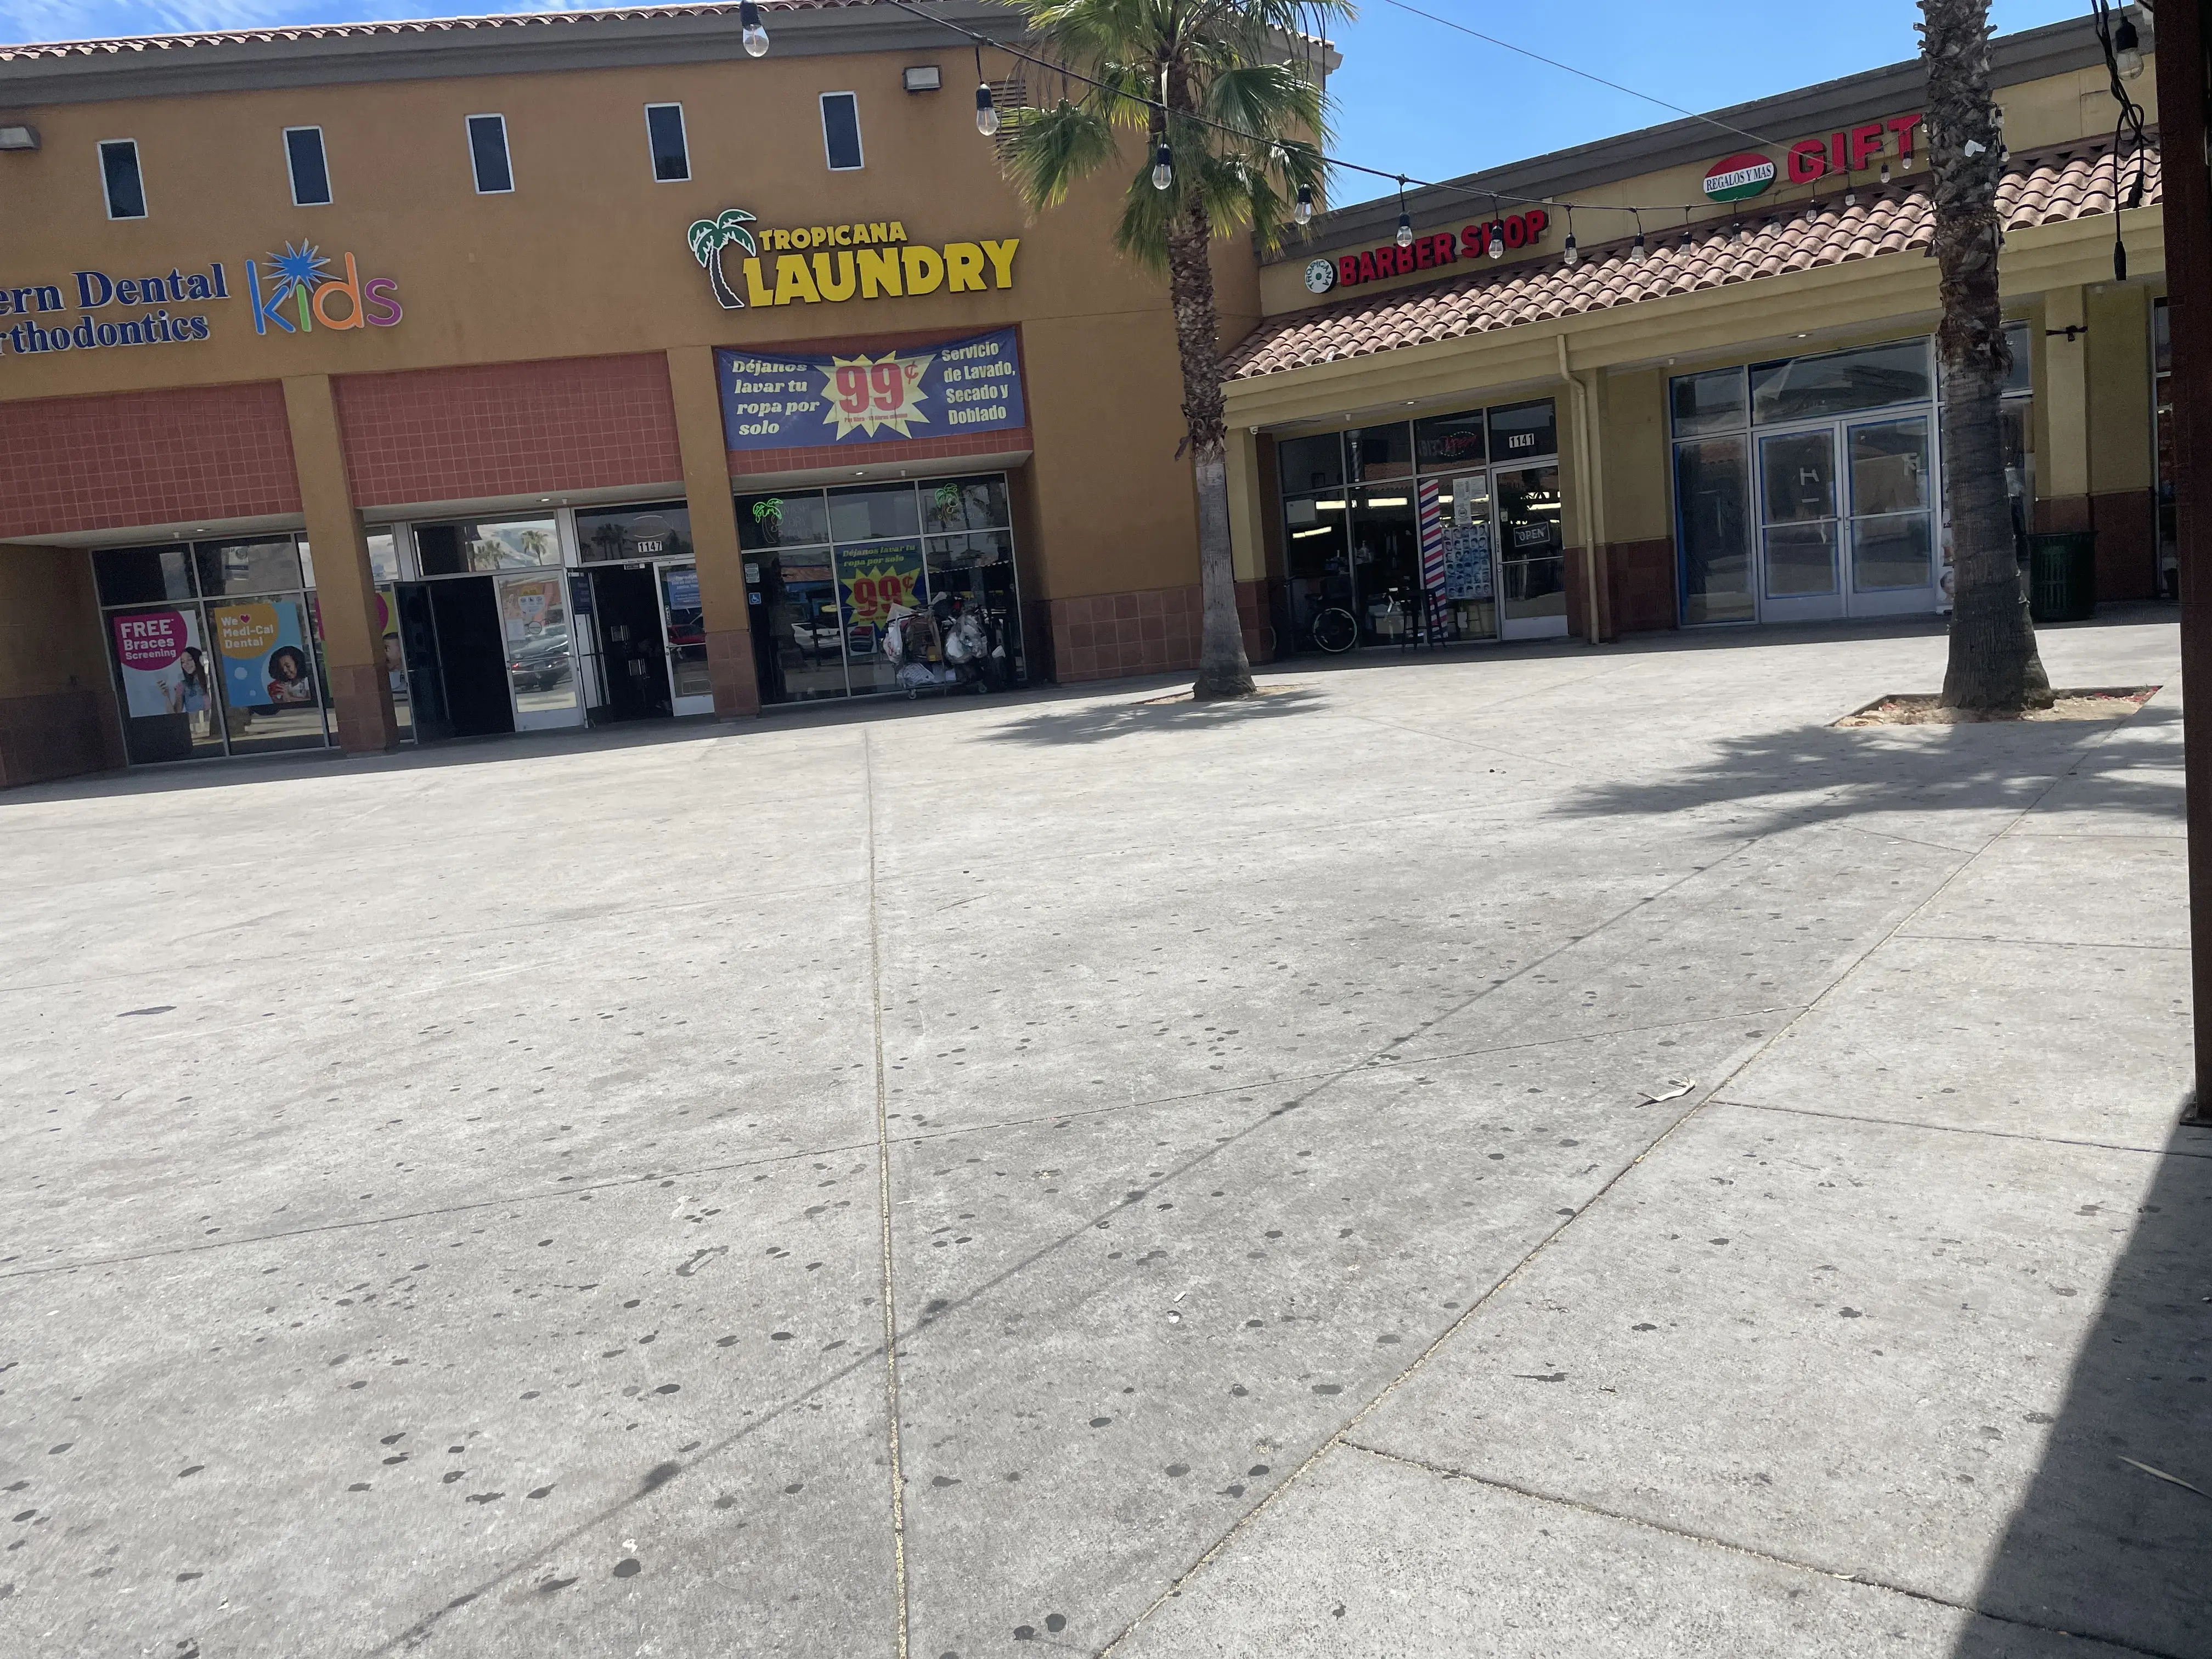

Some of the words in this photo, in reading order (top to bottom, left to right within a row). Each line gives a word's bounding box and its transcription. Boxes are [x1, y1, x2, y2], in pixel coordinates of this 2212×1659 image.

[1787, 114, 1922, 184] GIFT
[1706, 171, 1745, 191] REGALOS
[1746, 169, 1752, 181] Y
[1753, 165, 1772, 180] MAS
[759, 221, 908, 251] TROPICANA
[1339, 232, 1455, 287] BARBER
[1461, 209, 1547, 258] SHOP
[743, 239, 1020, 308] LAUNDRY
[70, 262, 230, 310] Dental
[941, 341, 1000, 362] Servicio
[732, 359, 808, 376] Déjanos
[944, 367, 962, 383] de
[964, 360, 1015, 380] Lavado,
[734, 379, 785, 394] lavar
[788, 380, 808, 392] tu
[946, 384, 998, 404] Secado
[1000, 384, 1008, 399] y
[736, 402, 783, 417] ropa
[785, 401, 820, 415] por
[948, 404, 1007, 425] Doblado
[738, 420, 780, 436] solo
[1510, 434, 1534, 448] 1141
[1518, 527, 1545, 541] OPEN
[638, 541, 662, 552] 1147
[843, 548, 878, 558] Déjanos
[844, 559, 866, 567] ropa
[867, 557, 884, 567] por
[885, 555, 905, 563] solo
[221, 616, 238, 626] We
[123, 637, 175, 651] Braces
[225, 636, 263, 649] Dental
[125, 648, 177, 661] Screening
